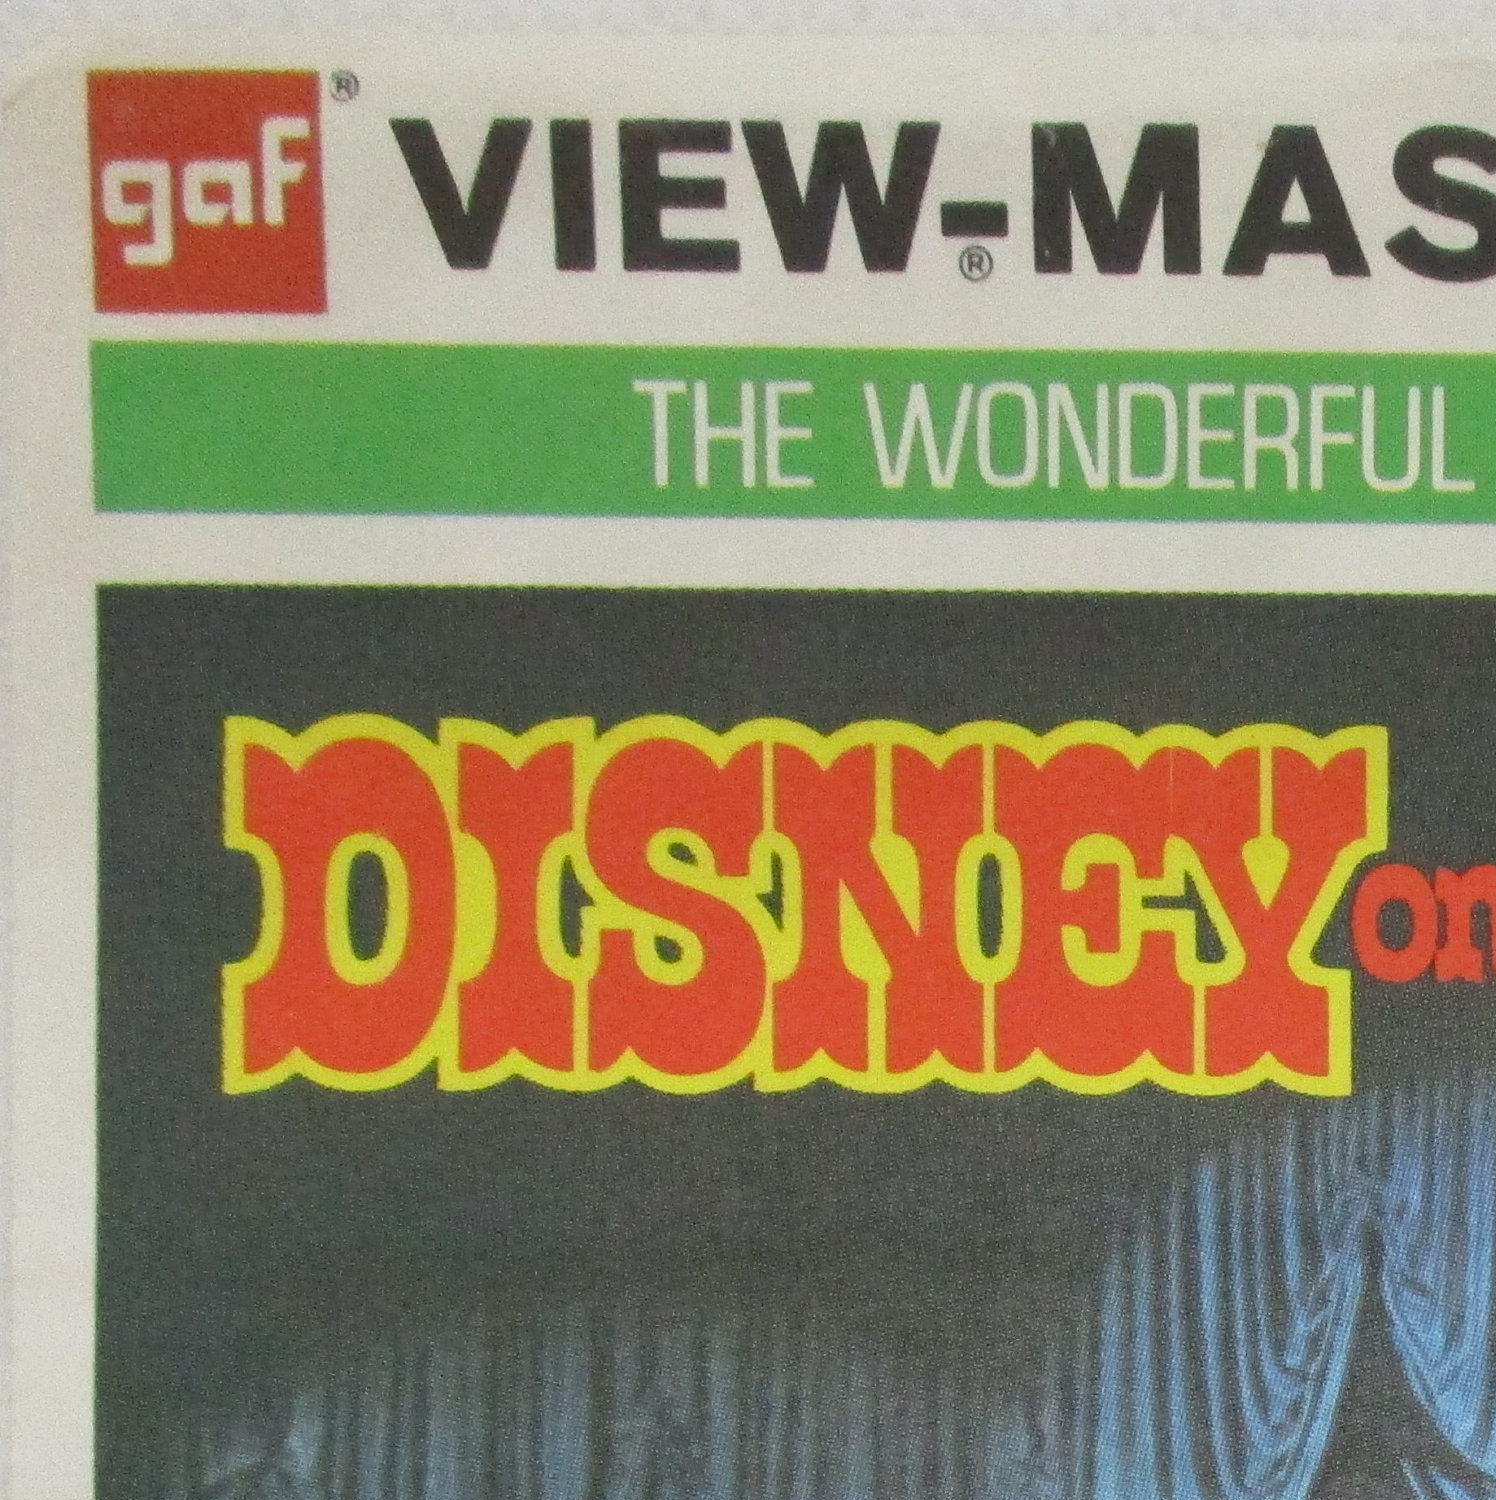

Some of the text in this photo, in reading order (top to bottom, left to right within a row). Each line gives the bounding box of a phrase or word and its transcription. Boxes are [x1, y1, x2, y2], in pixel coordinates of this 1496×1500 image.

[101, 116, 310, 267] gaf
[632, 379, 815, 490] THE
[863, 381, 1476, 493] WONDERFUL
[222, 712, 1389, 1097] DISNEY
